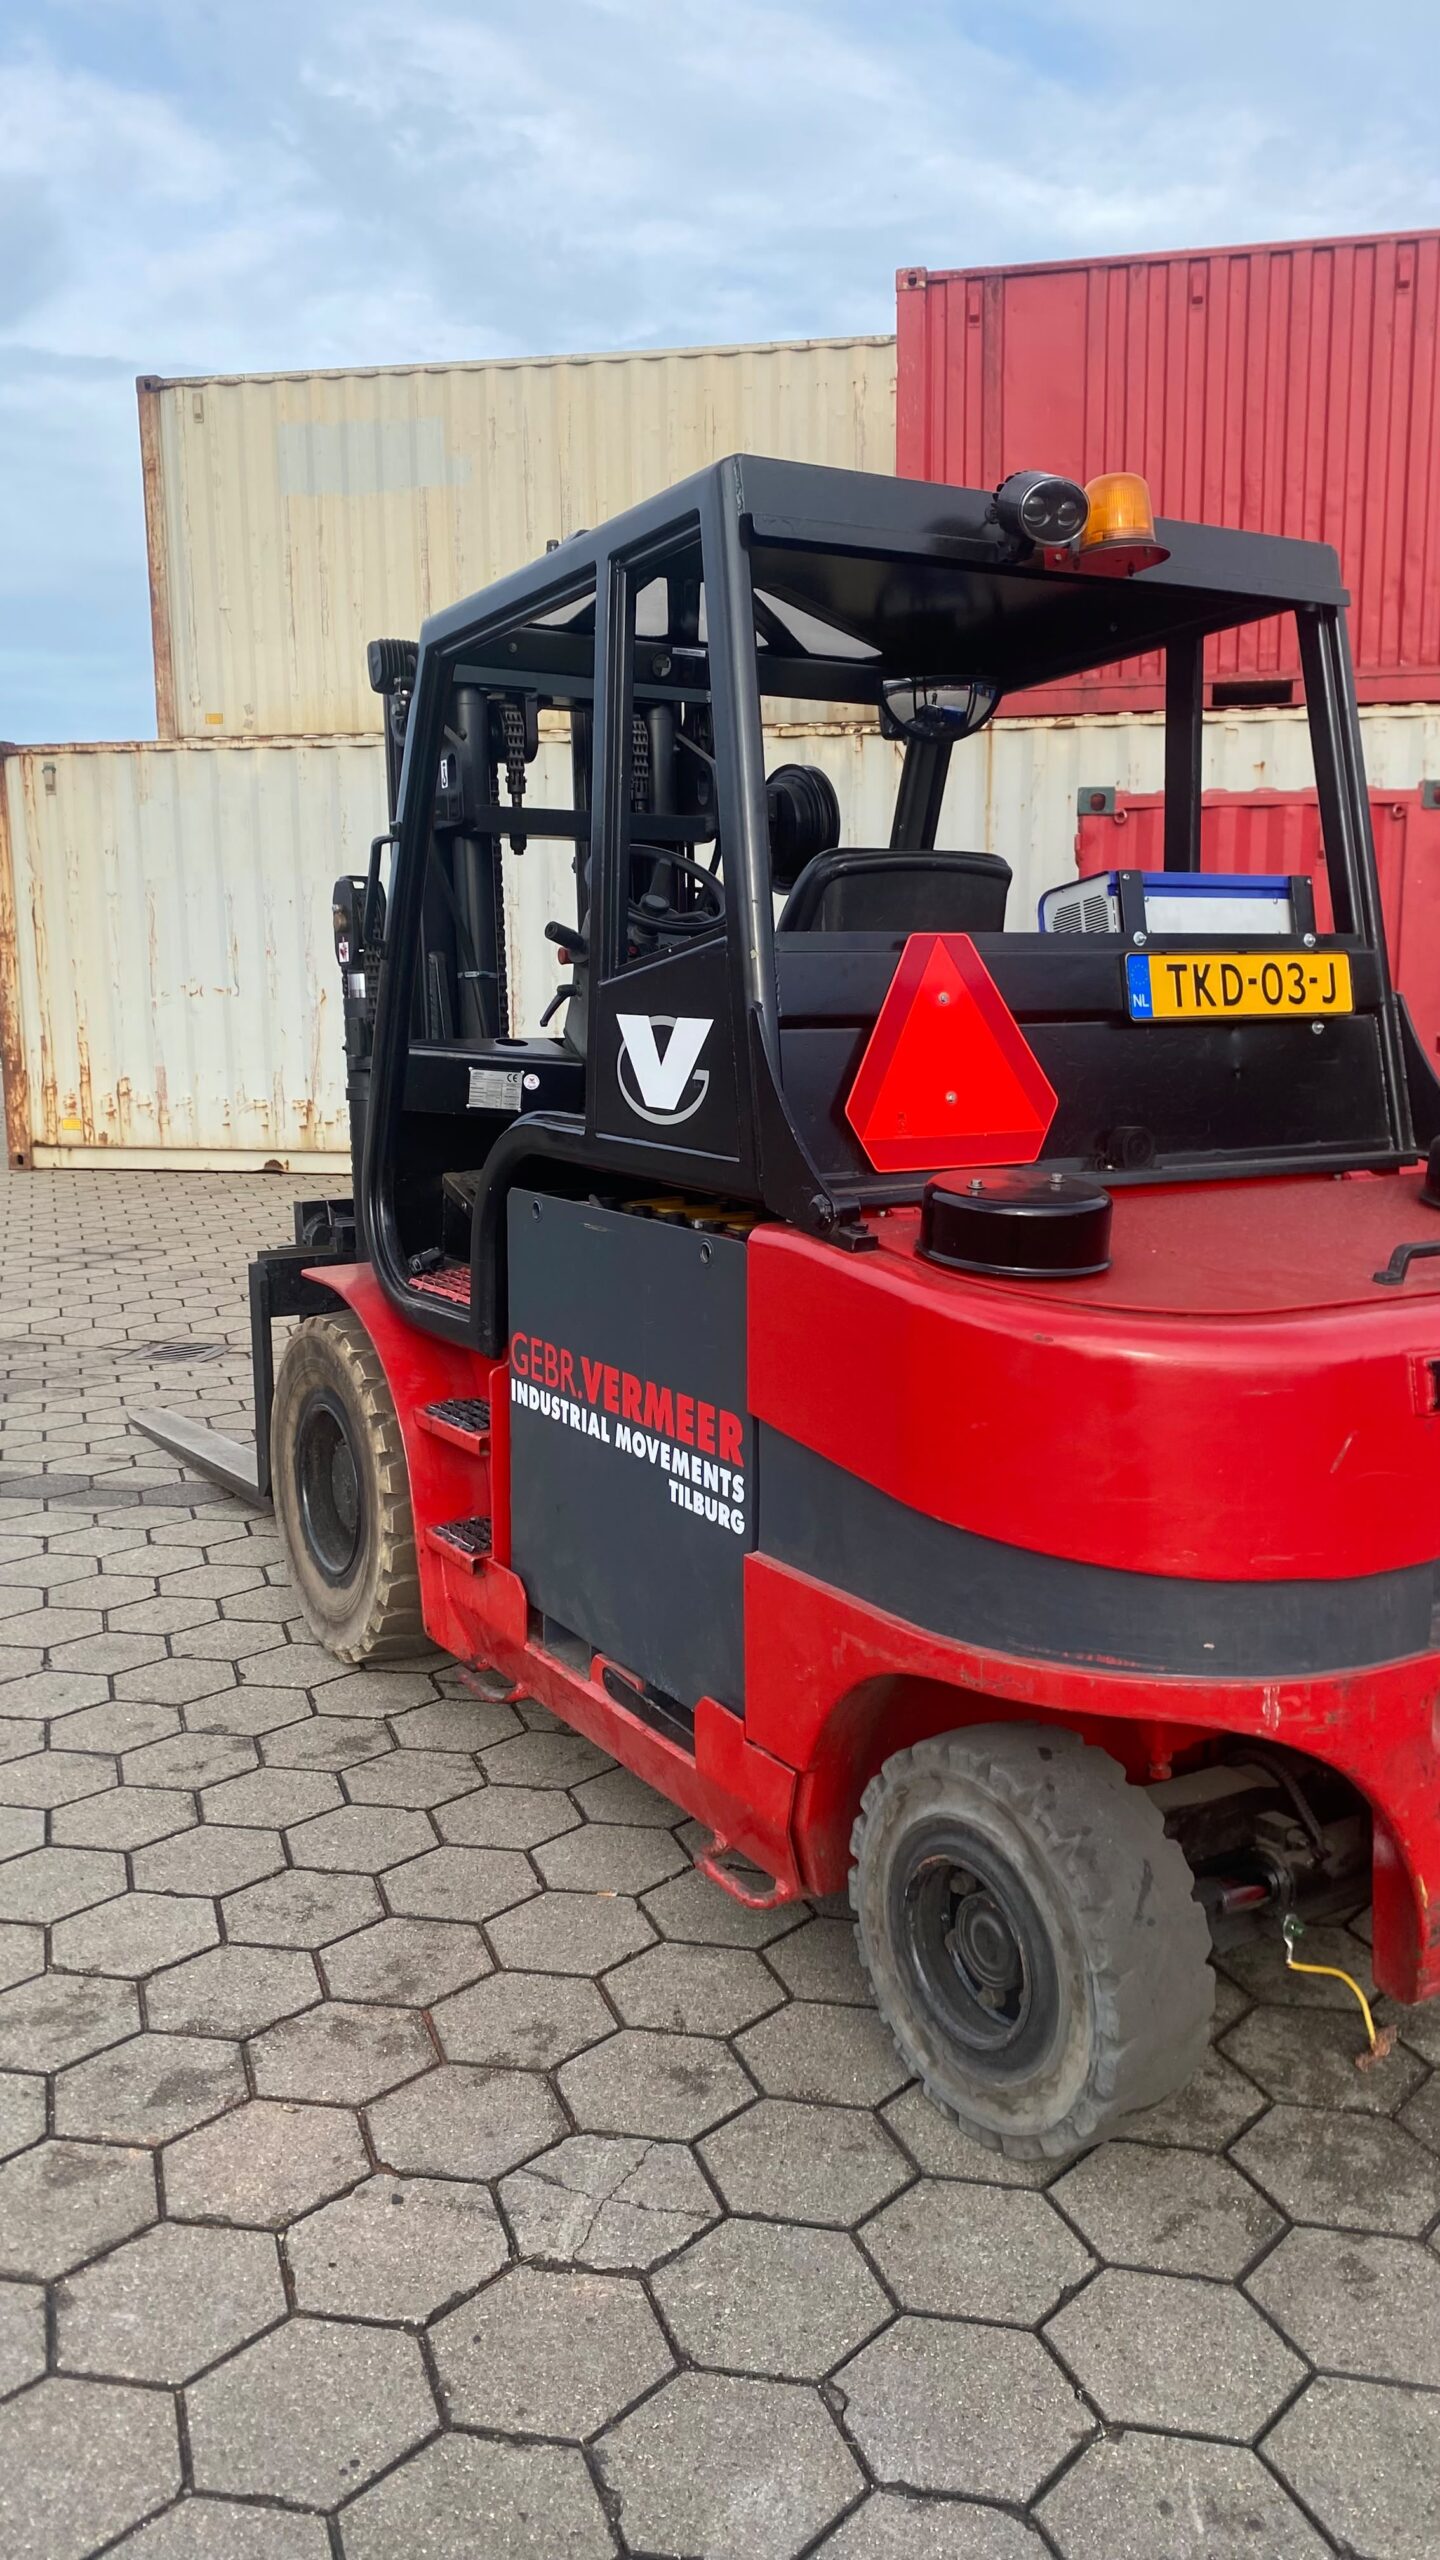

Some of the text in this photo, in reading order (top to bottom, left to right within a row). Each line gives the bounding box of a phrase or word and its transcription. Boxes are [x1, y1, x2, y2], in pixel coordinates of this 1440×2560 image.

[1132, 993, 1150, 1009] NL
[1166, 962, 1337, 1008] TKD-03-J
[511, 1378, 745, 1504] INDUSTRIAL MOVEMENTS
[668, 1479, 746, 1535] TILBURG
